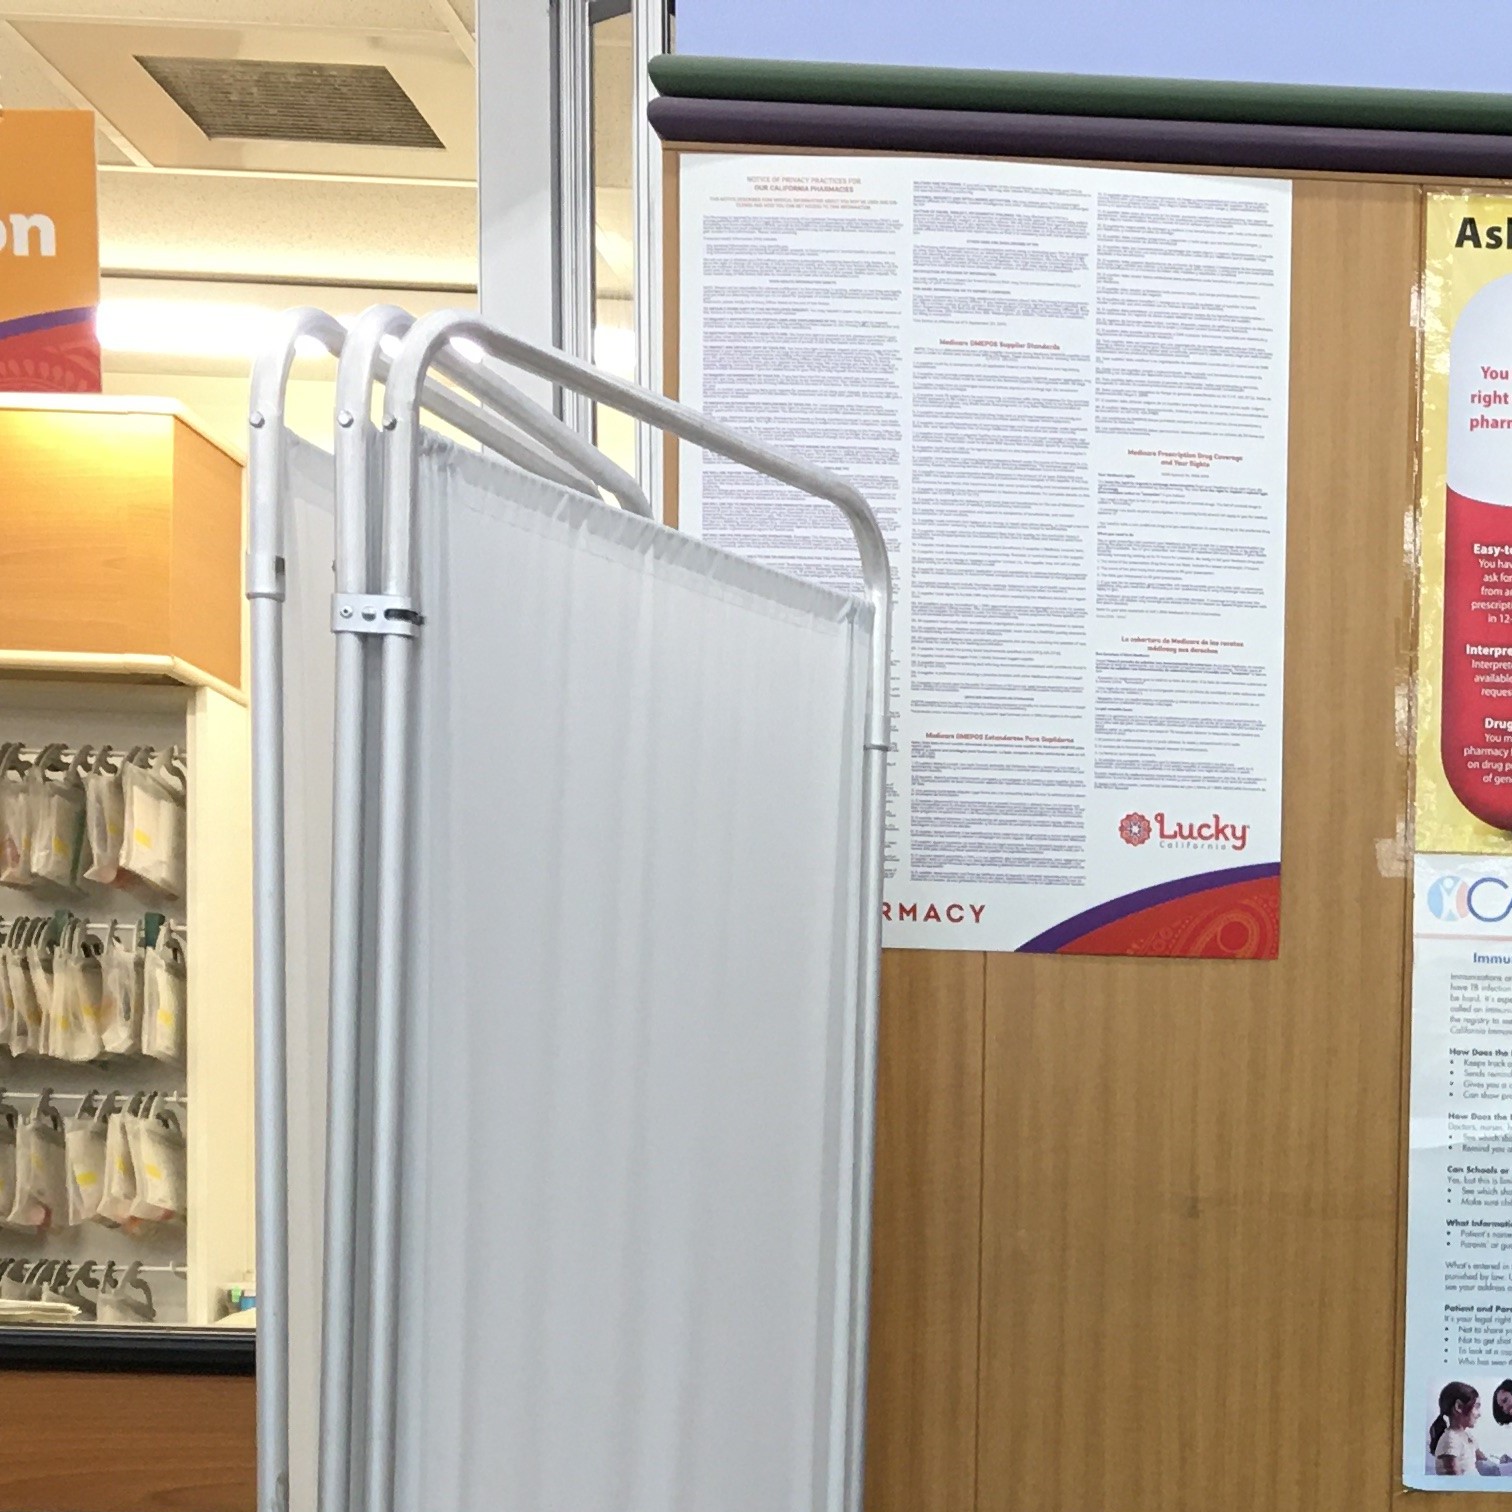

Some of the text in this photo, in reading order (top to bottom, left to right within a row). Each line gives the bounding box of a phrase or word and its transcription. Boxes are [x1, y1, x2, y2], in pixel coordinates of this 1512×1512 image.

[939, 338, 1060, 350] Medicare DMEPOS Supplier Standards
[1480, 366, 1508, 380] You
[1470, 391, 1508, 408] right
[1157, 450, 1196, 458] Prescription
[1197, 452, 1212, 460] Drug
[1213, 453, 1243, 462] Coverage
[1189, 460, 1210, 468] Rights
[1154, 812, 1246, 850] Lucky
[1159, 840, 1226, 850] California
[1444, 1304, 1474, 1312] Patient
